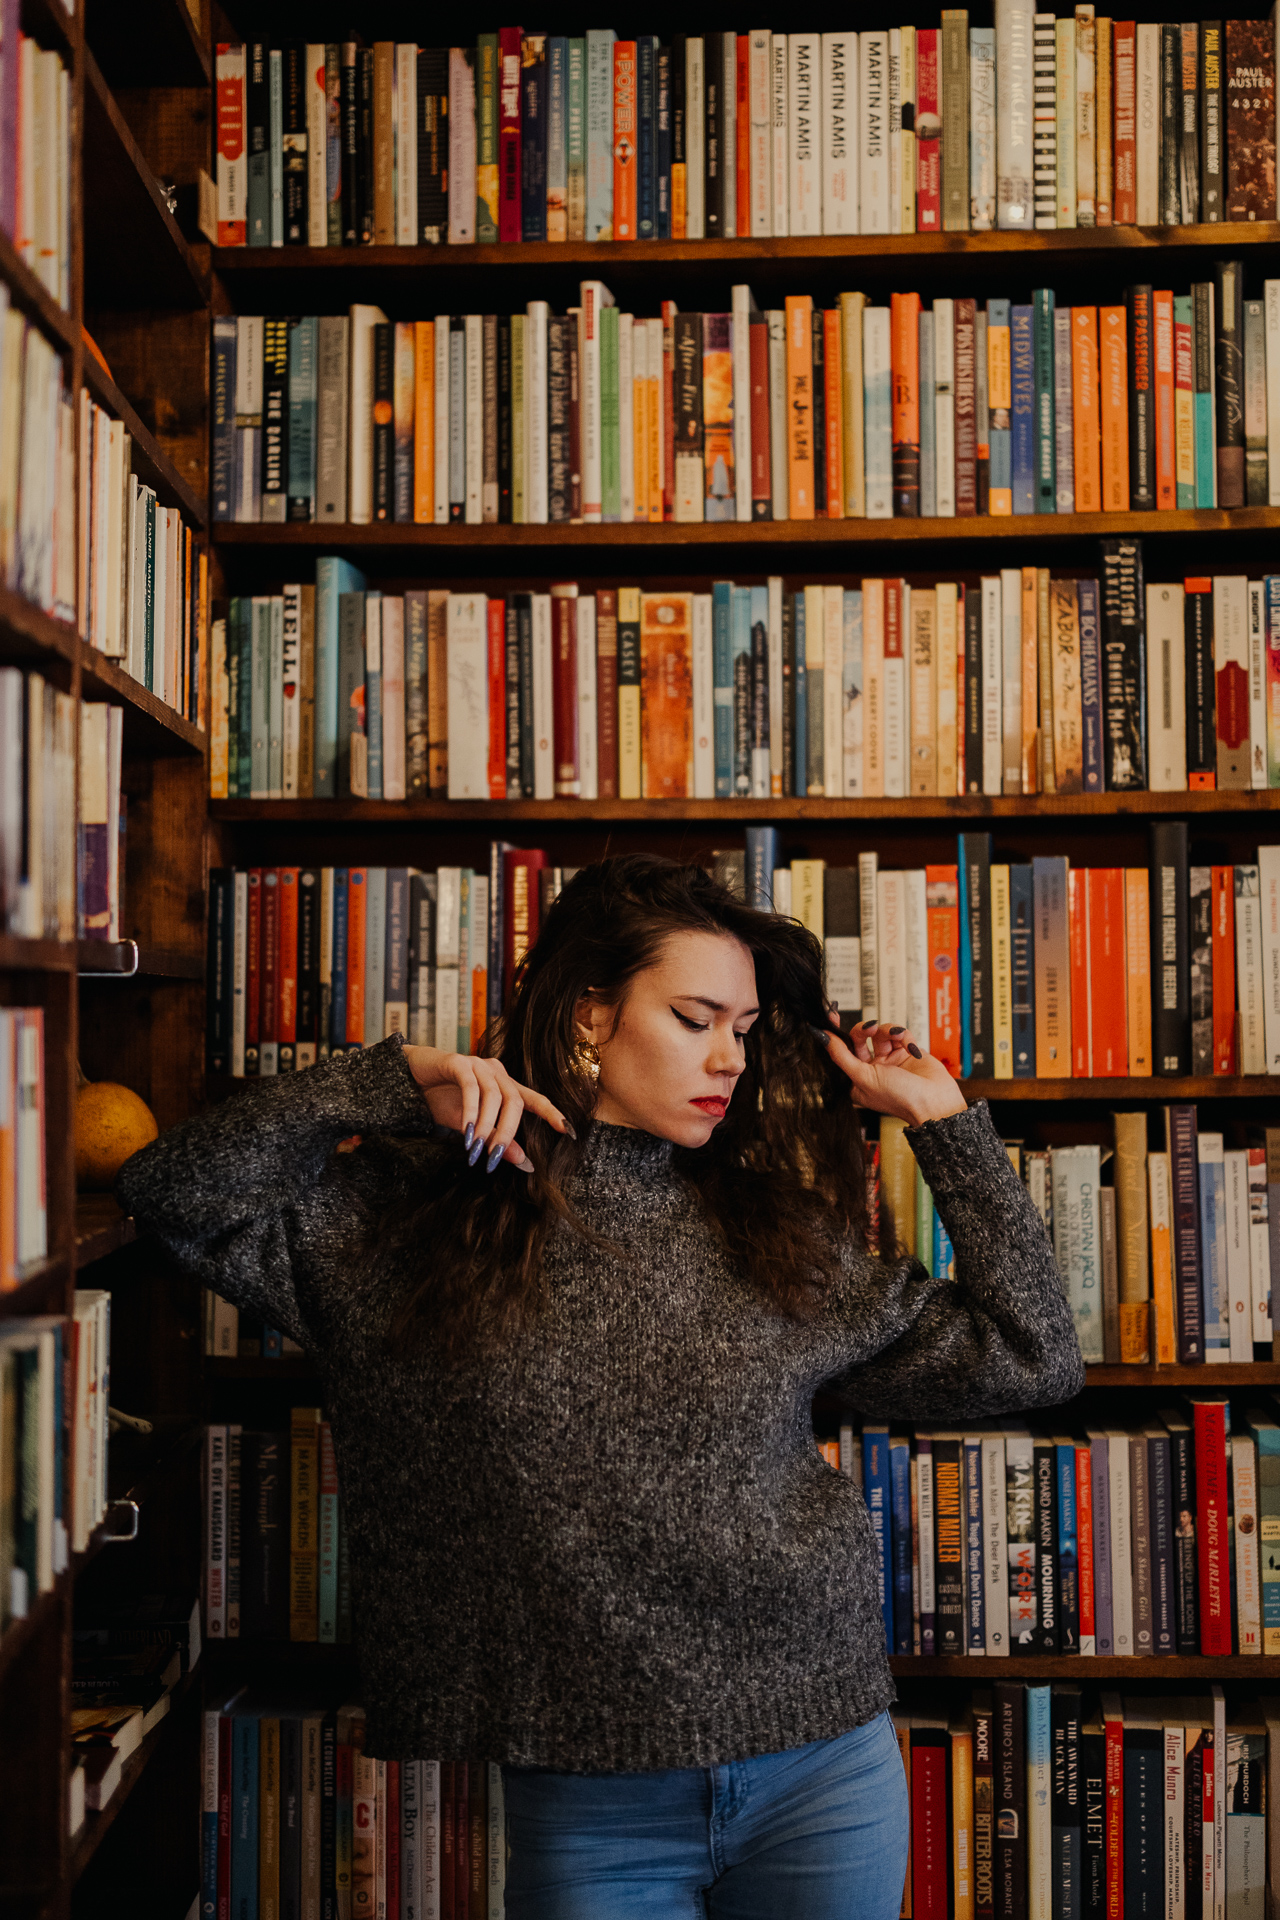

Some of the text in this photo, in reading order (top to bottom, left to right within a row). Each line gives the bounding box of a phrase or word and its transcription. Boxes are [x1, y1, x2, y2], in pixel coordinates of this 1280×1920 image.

[570, 48, 581, 156] RICH PRETTY
[615, 60, 635, 134] POWER
[774, 47, 785, 129] MARTIN AMIS
[796, 45, 812, 161] MARTIN AMIS
[830, 43, 847, 160] MARTIN AMIS
[866, 41, 883, 158] MARTIN AMIS
[888, 56, 900, 134] MARTIN AMIS
[1116, 37, 1135, 142] THE HANDMAID'S TALE
[1141, 73, 1154, 130] ATWOOD
[1182, 31, 1197, 133] PAUL AUSTER LEVIATHAN
[1204, 30, 1220, 175] PAUL AUSTER THE NEW YORK TRILOGY
[1227, 78, 1274, 89] AUSTER
[1235, 68, 1265, 78] PAUL
[264, 321, 276, 363] BANKS
[274, 321, 288, 375] RUSSELL
[678, 335, 698, 413] After Fire
[956, 323, 974, 415] POSTMISTRESS
[1013, 315, 1032, 416] MIDWIVES
[1076, 334, 1097, 407] Guernica
[1108, 334, 1127, 406] Guernica
[1133, 293, 1149, 391] THE PASSENGER
[1156, 302, 1173, 373] THE PASSENGER
[1177, 350, 1192, 383] BOYLE
[215, 352, 228, 425] AFFLICTION
[1218, 390, 1243, 442] Wonders
[213, 436, 228, 492] BANKS
[265, 389, 283, 491] THE DARLING
[956, 418, 974, 459] SARAH
[1040, 392, 1051, 480] COWBOY GRAVES
[956, 461, 974, 499] BLAKE
[1104, 555, 1121, 617] DAVIES
[1119, 547, 1137, 626] ROBERTSON
[283, 594, 298, 675] HELL
[621, 630, 636, 677] CASEY
[914, 609, 932, 665] SHARPE'S
[1056, 593, 1076, 657] ZABOR
[1080, 592, 1099, 706] THE BOHEMIANS
[603, 659, 613, 745] JOHN CASEY
[869, 678, 878, 770] ROBERT COOVER
[988, 687, 998, 744] THE HOURS
[1125, 679, 1136, 701] THE
[624, 699, 633, 755] SPARTINA
[513, 866, 529, 933] WASHINGTON
[885, 880, 898, 954] BIRDSONG
[997, 888, 1007, 928] BURNING
[972, 865, 984, 1035] RICHARD FLANAGAN First Person
[997, 938, 1007, 970] MEGHA
[1162, 866, 1177, 1009] JONATHAN FRANZEN FREEDOM
[997, 975, 1007, 1026] MAJUMDAR
[1046, 966, 1058, 1037] JOHN FOWLES
[1176, 1111, 1195, 1205] THOMAS KENEALLY
[1070, 1202, 1081, 1272] SON OF THE LIGHT
[1080, 1181, 1097, 1290] CHRISTIAN JACQ
[1180, 1228, 1200, 1337] OFFICE OF INNOCENCE
[256, 1444, 278, 1537] My Struggle
[297, 1448, 311, 1496] MAGIC
[1013, 1454, 1032, 1526] MAKIN
[1154, 1442, 1168, 1552] HENNING MANKELL
[211, 1437, 224, 1609] KARL OVE KNAUSGAARD WINTER
[297, 1498, 311, 1550] WORDS
[936, 1462, 961, 1563] NORMAN MAILER
[967, 1450, 983, 1629] Norman Mailer Tough Guys Don't Dance
[1039, 1457, 1055, 1629] RICHARD MAKIN MOURNING
[1017, 1548, 1033, 1621] WORK
[1206, 1508, 1221, 1617] DOUG MARLETTE
[976, 1718, 991, 1763] MOORE
[1002, 1702, 1014, 1799] ARTURO'S ISLAND
[1036, 1694, 1050, 1782] John Mortimer
[1055, 1728, 1067, 1766] BLACK
[1067, 1718, 1079, 1806] THE AWKWARD
[1165, 1733, 1183, 1802] Alice Munro
[1242, 1744, 1251, 1805] IRIS MURDOCH
[424, 1800, 437, 1894] The Children Act
[443, 1802, 455, 1854] amsterdam
[1086, 1777, 1104, 1850] ELMET
[976, 1813, 993, 1905] BITTER ROOTS
[1004, 1848, 1014, 1915] ELSA MORANTE
[1090, 1854, 1101, 1907] Fiona Mozley
